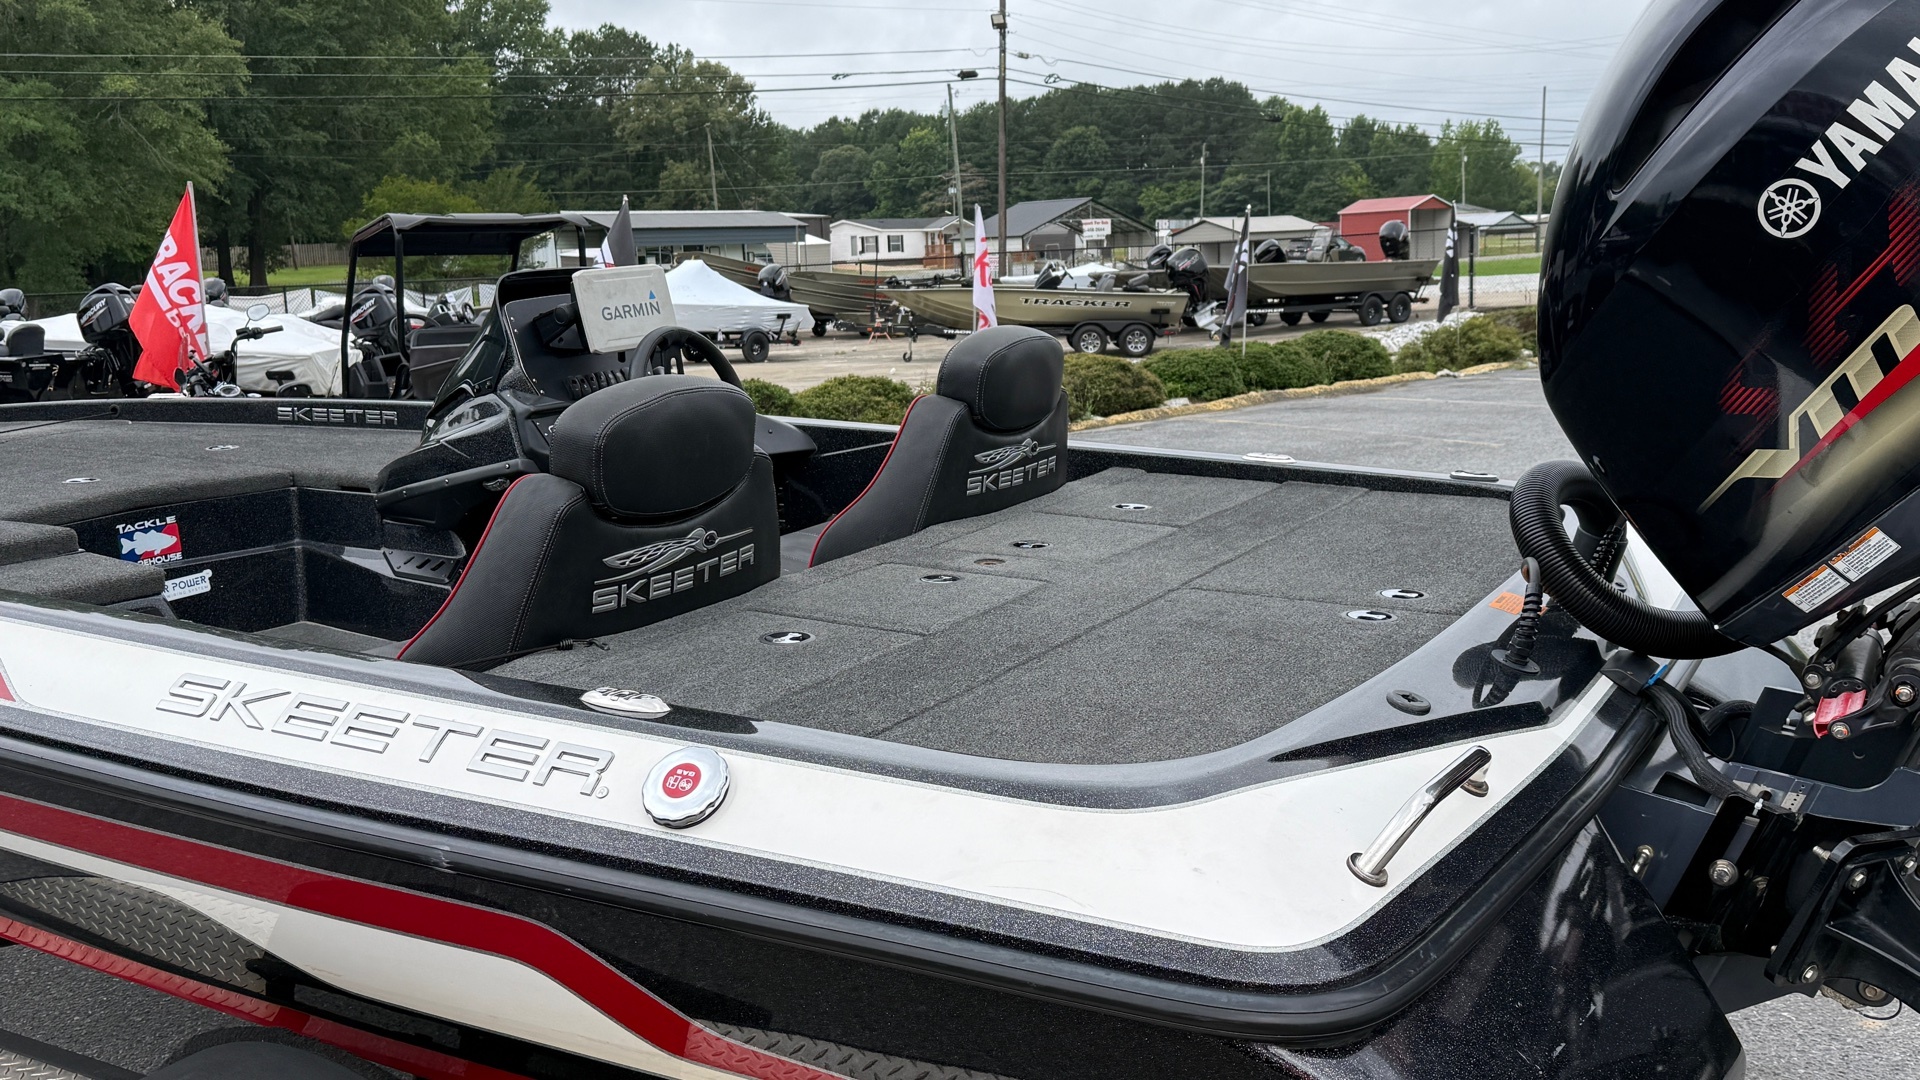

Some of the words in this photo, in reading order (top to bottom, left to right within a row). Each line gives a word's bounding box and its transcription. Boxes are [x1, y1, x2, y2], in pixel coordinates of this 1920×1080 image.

[1794, 37, 1920, 190] YAMA
[153, 229, 209, 358] RACK
[1019, 297, 1132, 309] TRACKER
[601, 301, 661, 321] GARMIN
[277, 406, 398, 425] SKEETER
[966, 455, 1057, 496] SKEETER
[115, 515, 177, 534] TACKLE
[171, 575, 207, 592] POWER
[591, 543, 755, 614] SKEETER
[155, 672, 616, 797] SKEETER
[676, 768, 696, 777] GAS
